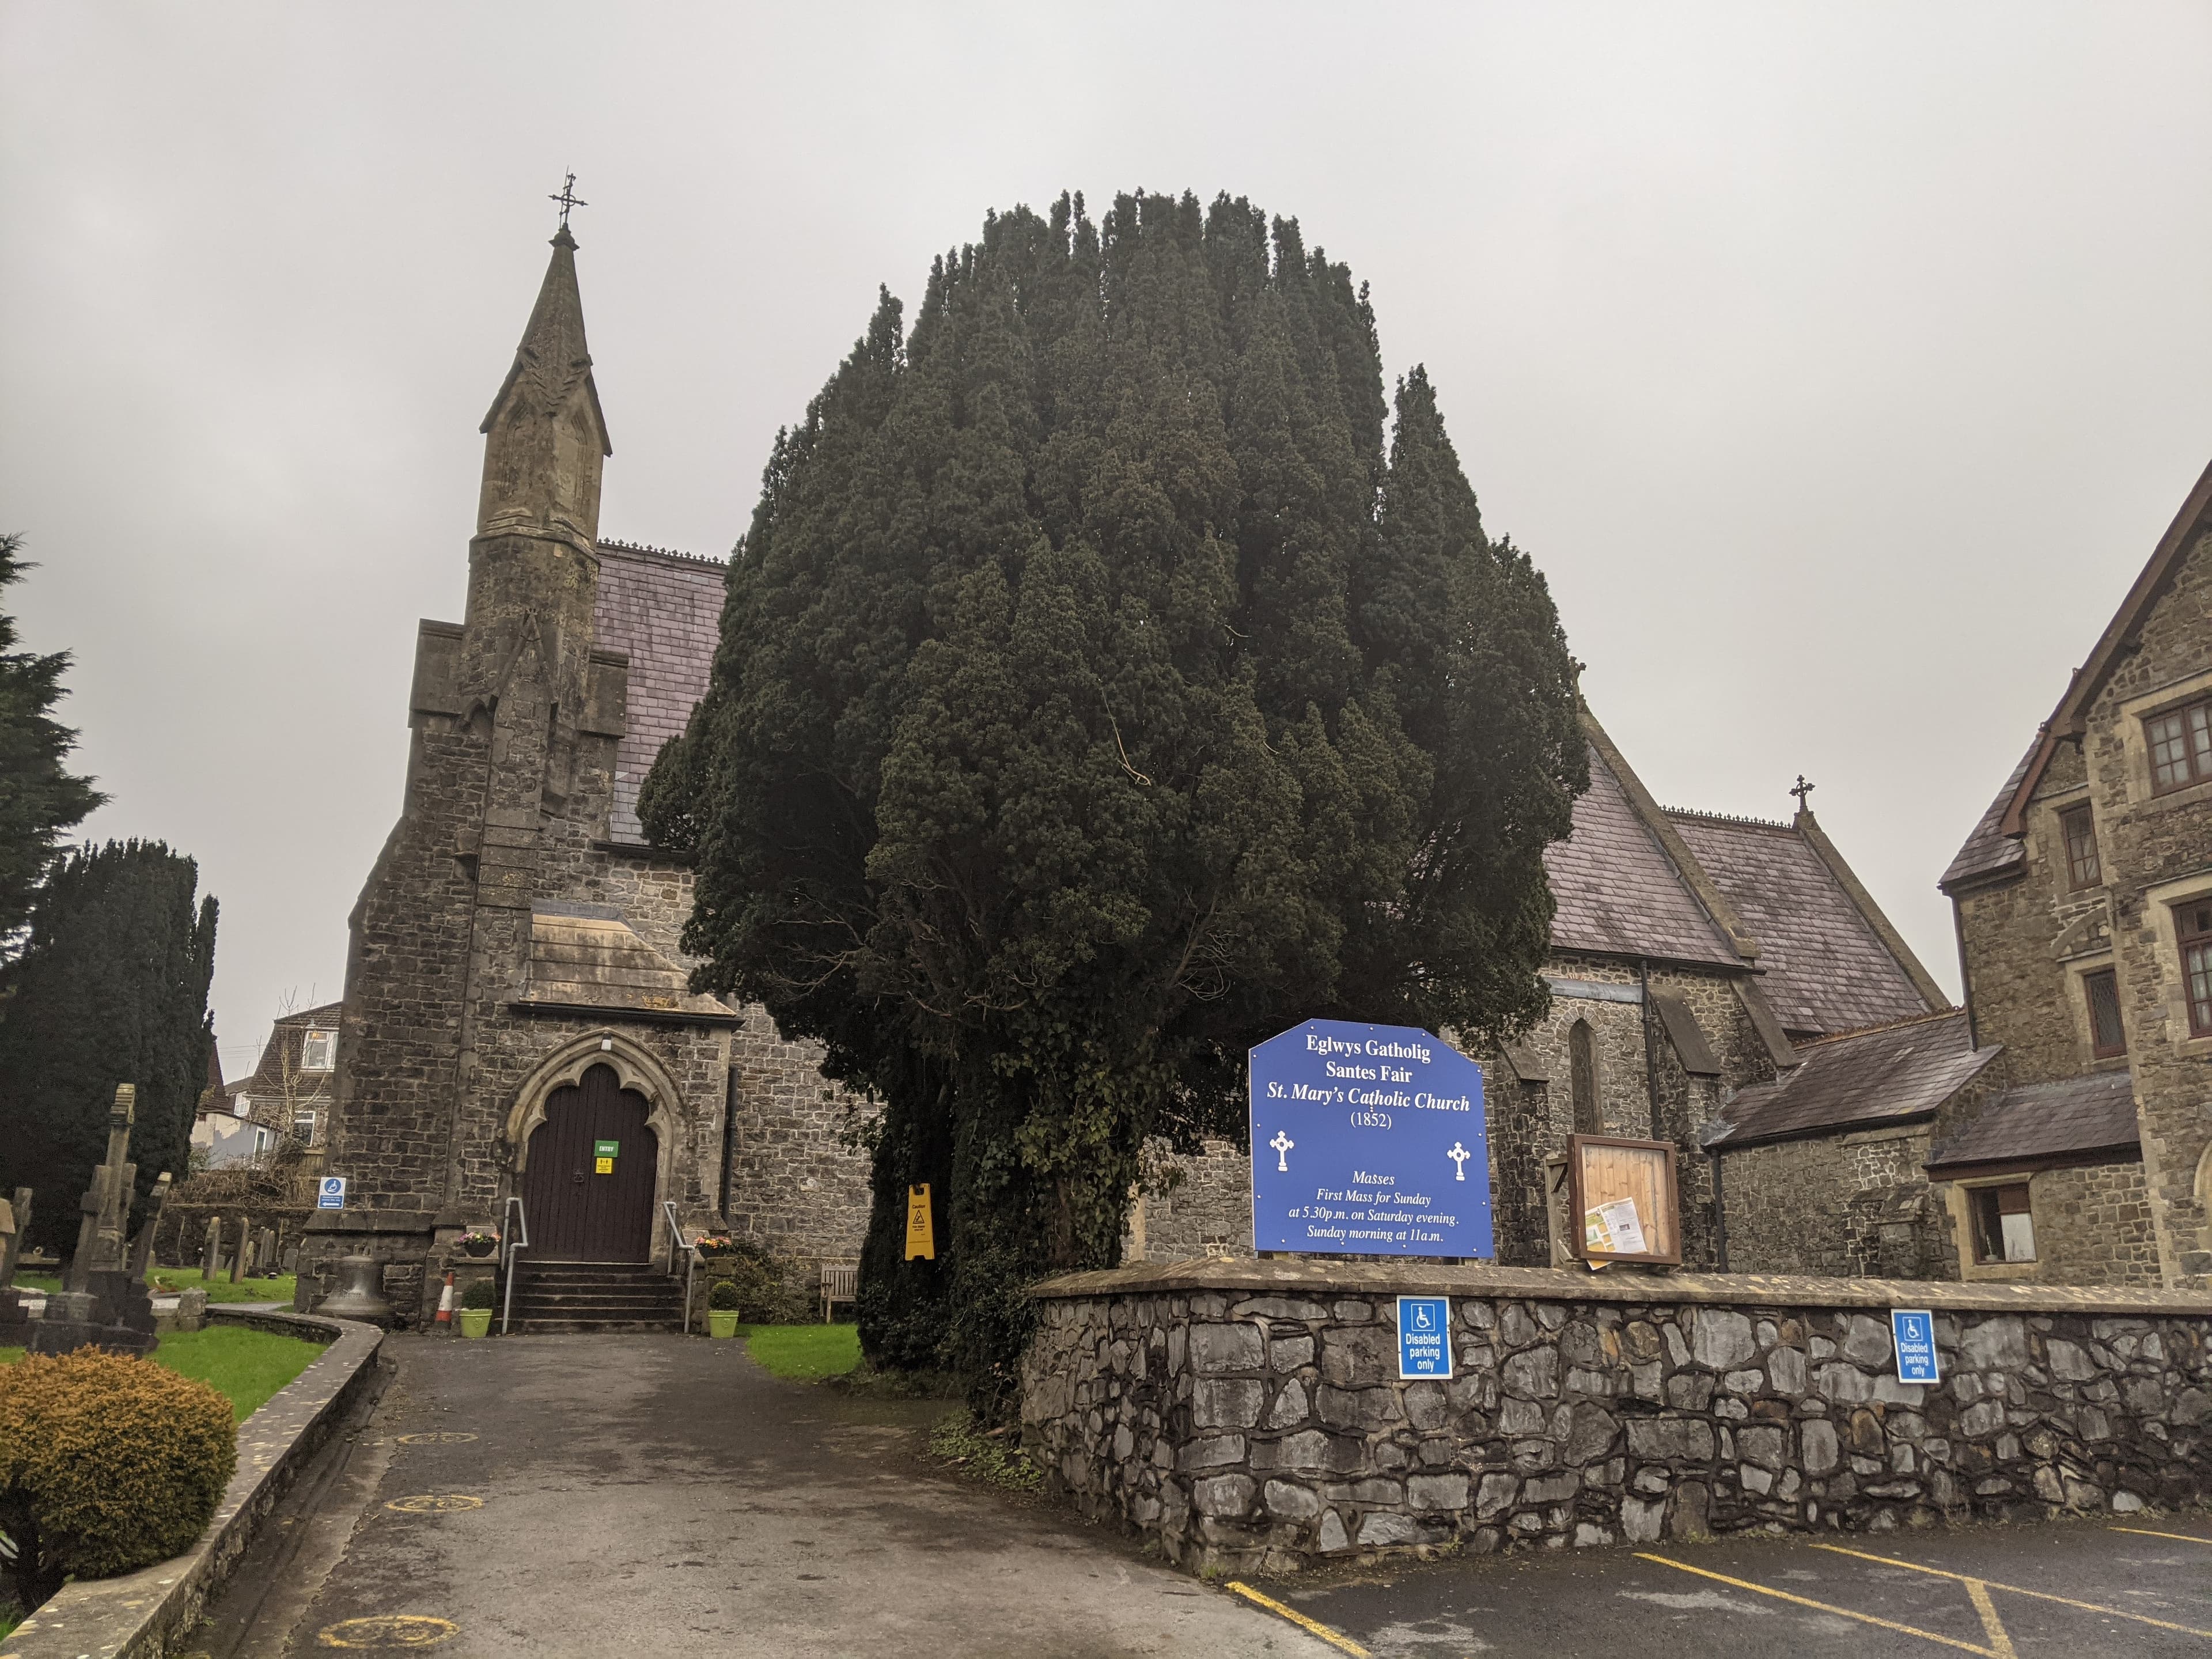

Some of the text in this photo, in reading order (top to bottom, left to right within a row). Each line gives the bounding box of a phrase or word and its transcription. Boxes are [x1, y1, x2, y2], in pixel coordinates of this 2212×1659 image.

[1306, 1035, 1431, 1063] Eglwys Gatholig
[1326, 1062, 1412, 1083] Santes Fair
[1267, 1082, 1470, 1111] St. Mary's Catholic Church
[1350, 1112, 1392, 1129] (1852)
[1352, 1171, 1395, 1185] Masses
[1316, 1188, 1431, 1207] First Mass for Sunday
[1289, 1207, 1300, 1218] at
[1351, 1211, 1365, 1220] on
[1367, 1209, 1414, 1225] Saturday
[1416, 1214, 1459, 1226] evening.
[1307, 1225, 1444, 1243] Sunday morning at 11a.m.
[1406, 1333, 1441, 1344] Disabled
[1410, 1347, 1440, 1360] parking
[1900, 1342, 1928, 1353] Disabled
[1417, 1358, 1434, 1372] only
[1905, 1354, 1929, 1366] parking
[1911, 1365, 1925, 1377] only
